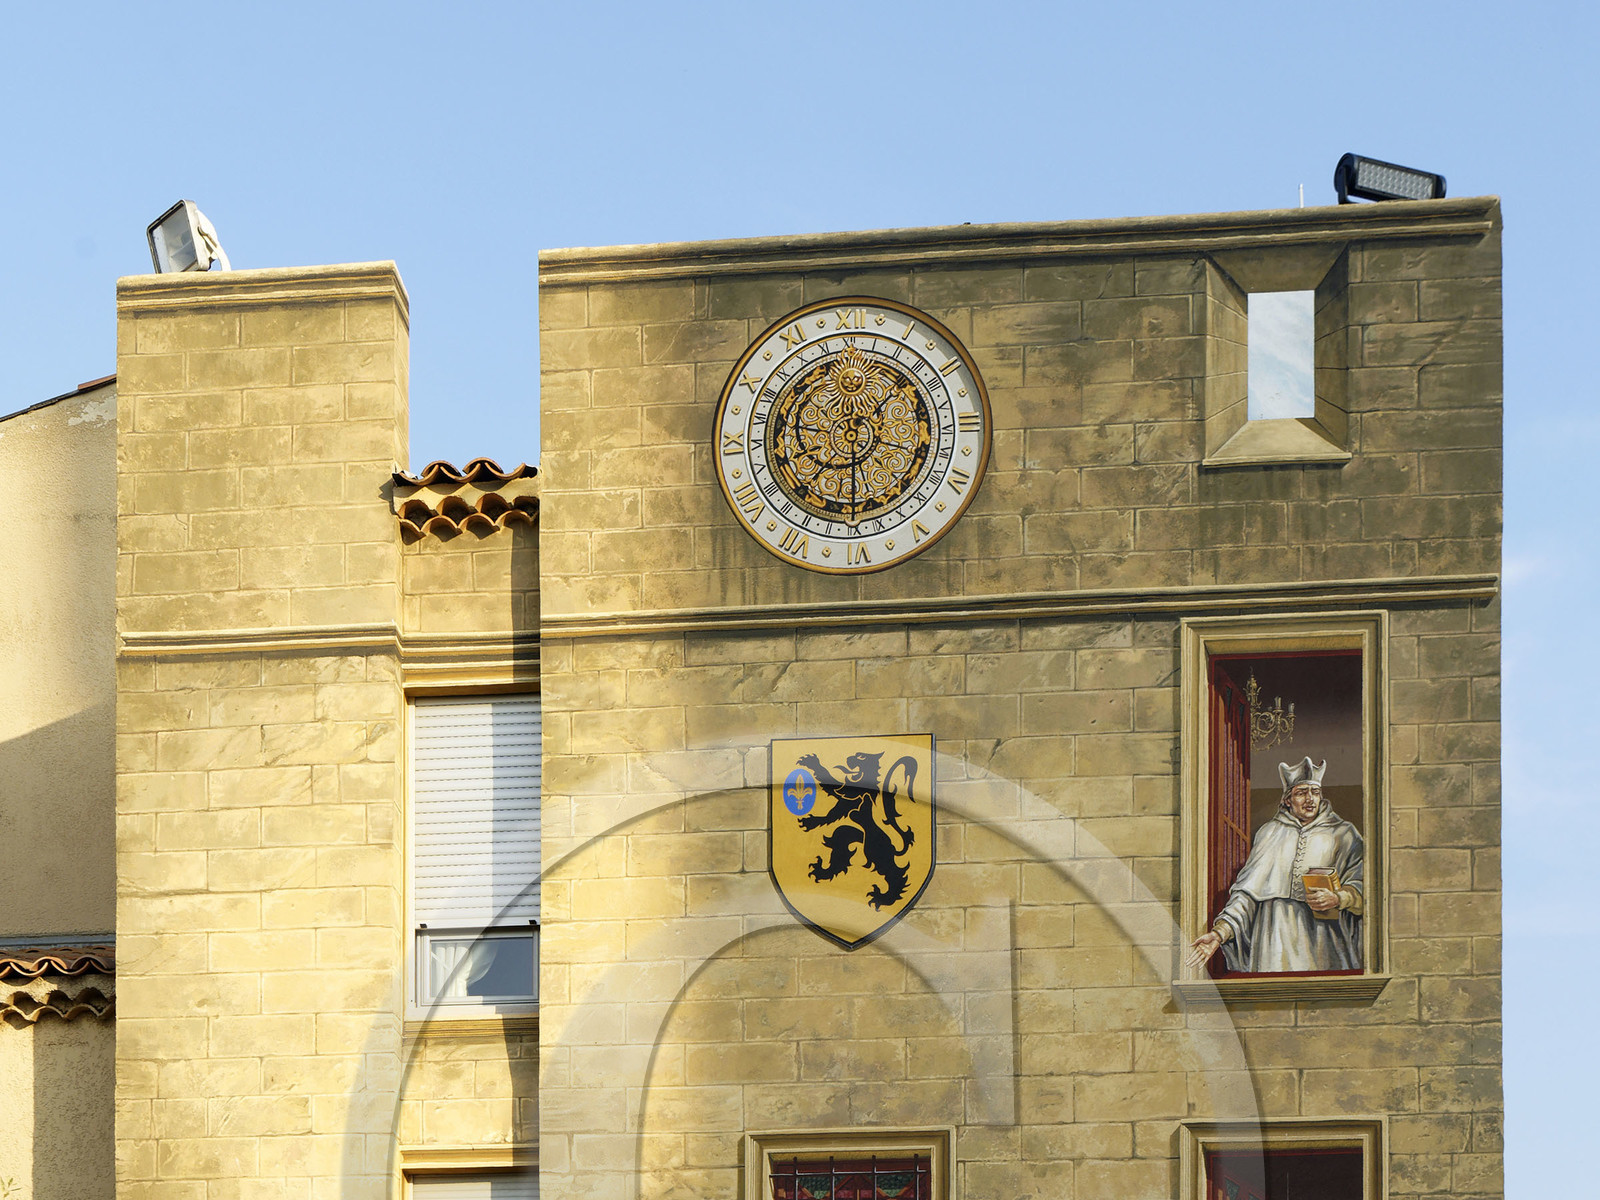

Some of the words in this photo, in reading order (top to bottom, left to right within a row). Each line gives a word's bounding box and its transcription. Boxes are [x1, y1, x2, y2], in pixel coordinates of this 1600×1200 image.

[835, 309, 867, 330] XII
[902, 320, 916, 340] I
[779, 322, 808, 352] XI
[938, 356, 961, 378] II
[739, 370, 763, 395] X
[958, 411, 980, 432] III
[723, 430, 744, 456] IX
[947, 466, 970, 495] IV
[733, 480, 766, 523] VIII
[778, 526, 809, 559] VII
[911, 519, 930, 543] V
[847, 542, 872, 565] VI
